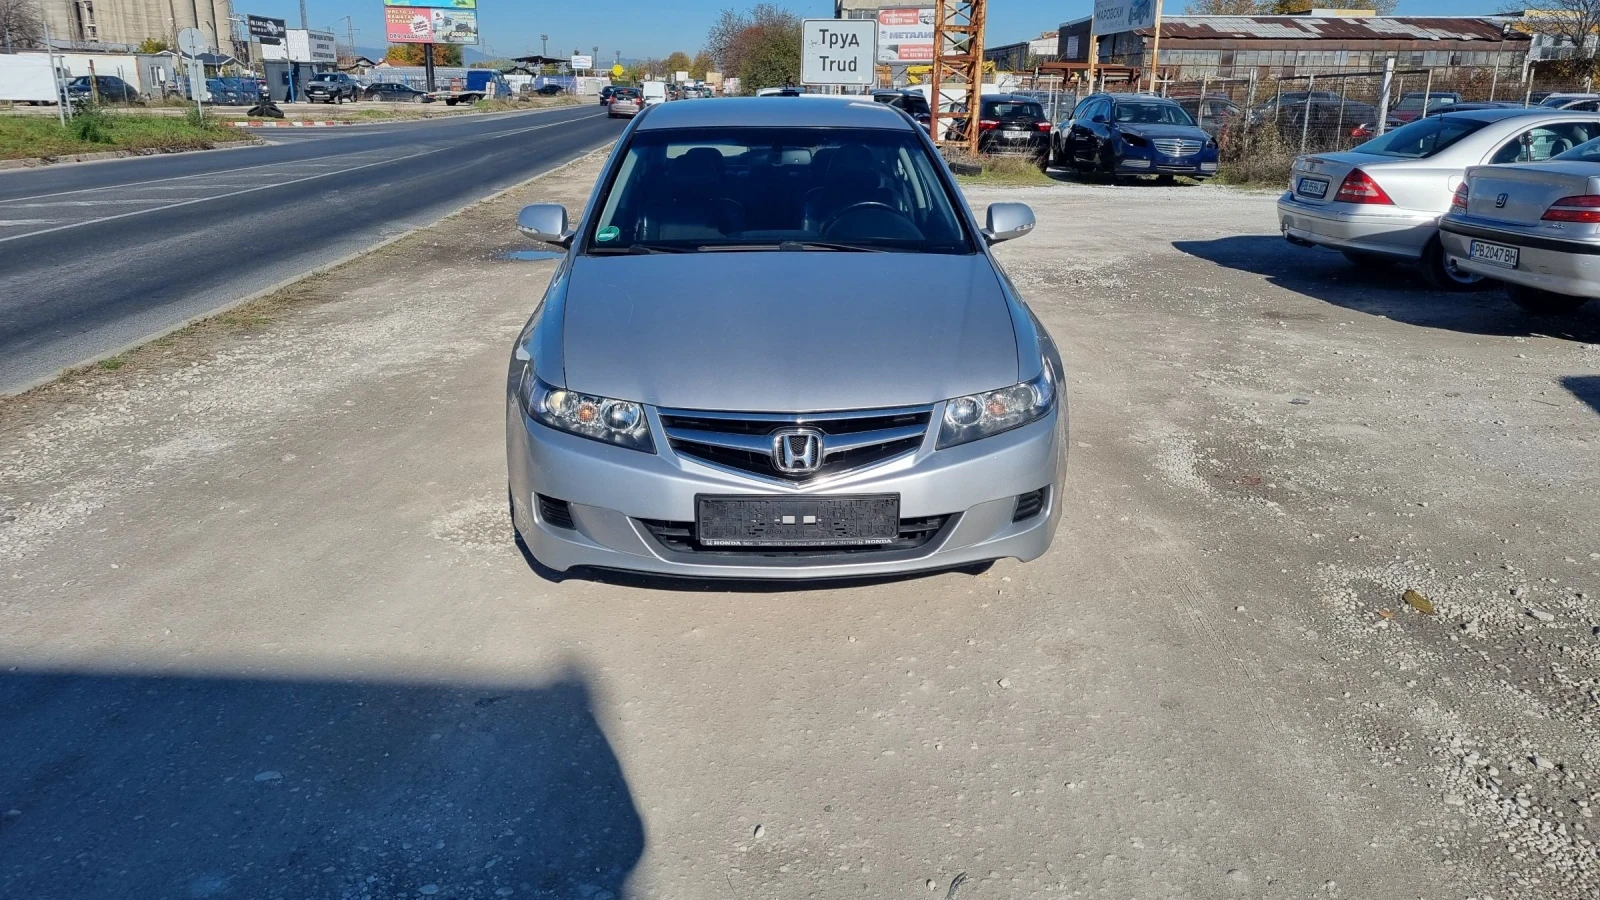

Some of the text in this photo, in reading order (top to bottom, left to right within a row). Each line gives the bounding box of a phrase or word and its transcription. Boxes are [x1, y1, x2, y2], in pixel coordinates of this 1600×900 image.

[1096, 7, 1124, 20] МАРОВСКИ
[819, 29, 859, 49] Труд
[819, 56, 857, 72] Trud
